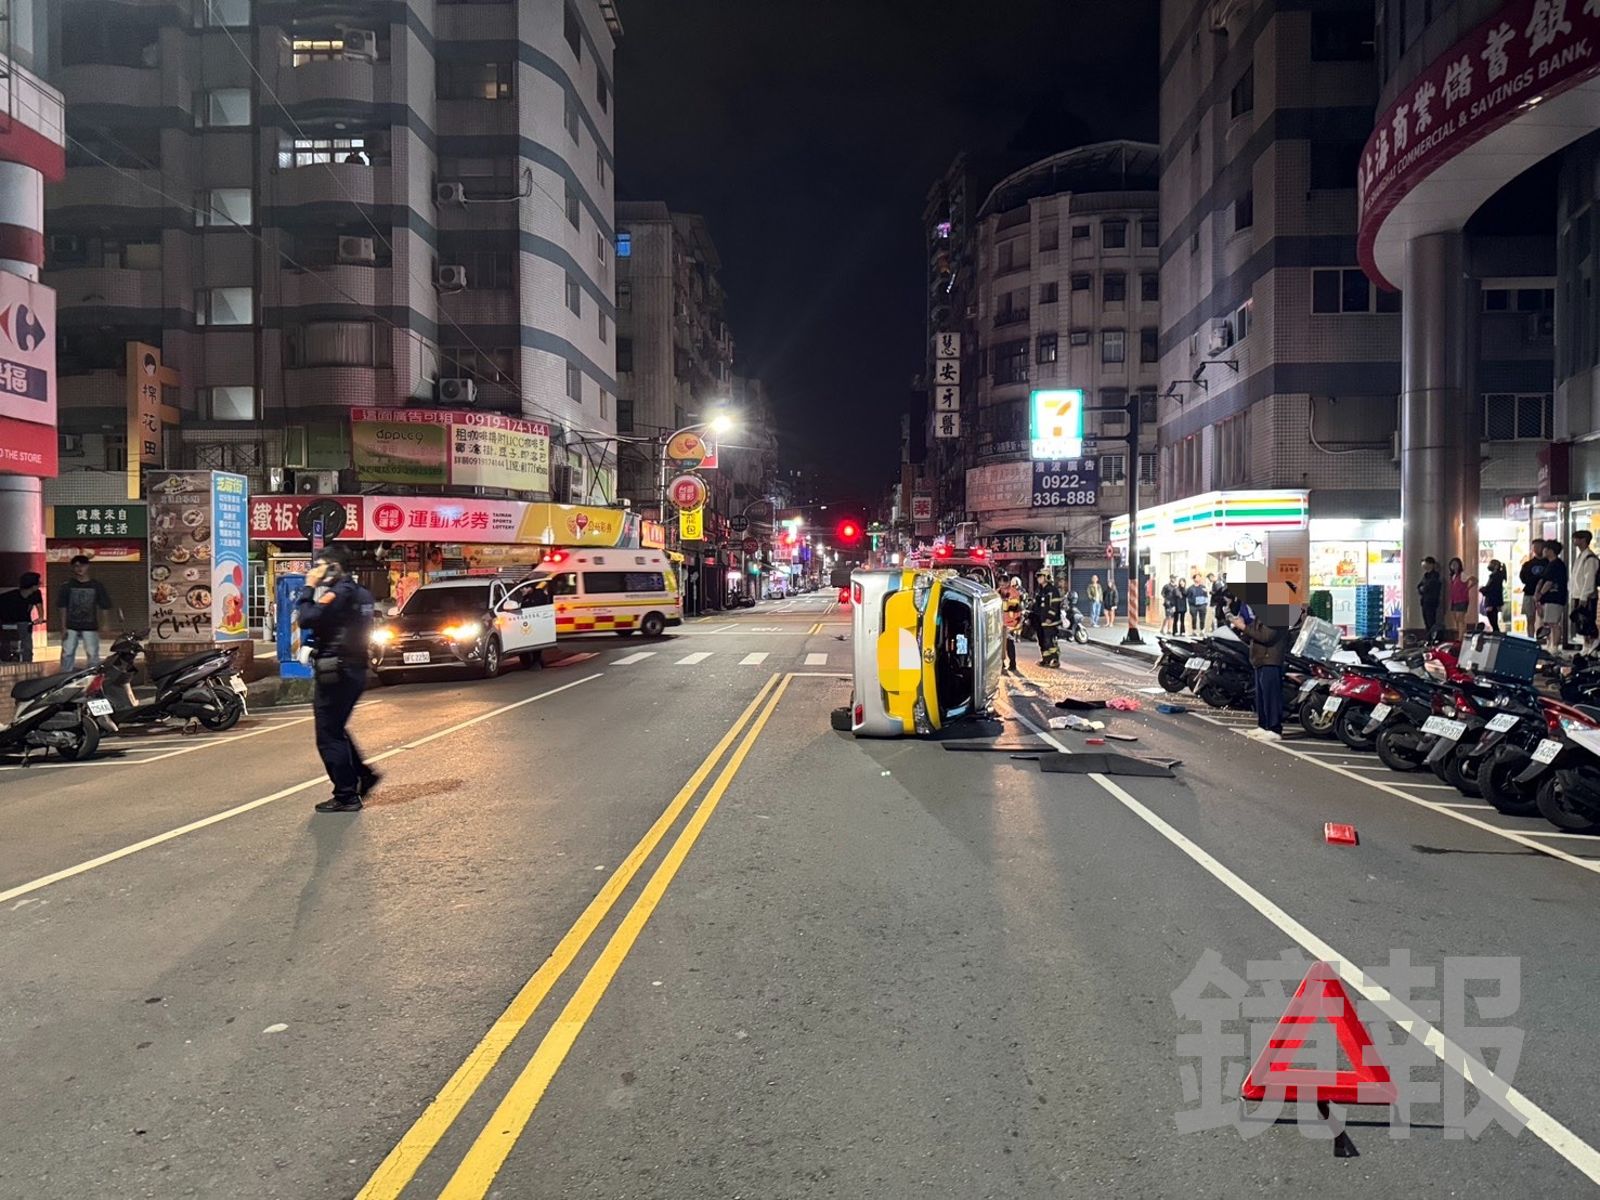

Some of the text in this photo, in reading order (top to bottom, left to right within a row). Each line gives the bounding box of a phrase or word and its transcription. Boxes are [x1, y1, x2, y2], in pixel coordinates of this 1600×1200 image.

[1363, 0, 1600, 195] 上海商業儲蓄銀
[1397, 119, 1456, 174] COMMERCIAL
[1458, 111, 1468, 127] &
[1470, 68, 1534, 120] SAVINGS
[0, 362, 28, 393] 福
[939, 334, 958, 436] 慧安牙醫
[465, 413, 546, 436] 0919-174-144
[4, 448, 42, 464] THE STORE
[1042, 475, 1087, 489] 0922-
[1033, 491, 1096, 506] 336-888
[76, 509, 127, 520] 健康來自
[408, 510, 489, 529] 運動彩券
[76, 523, 128, 535] 有機生活
[153, 607, 173, 619] the
[157, 612, 211, 640] Chips
